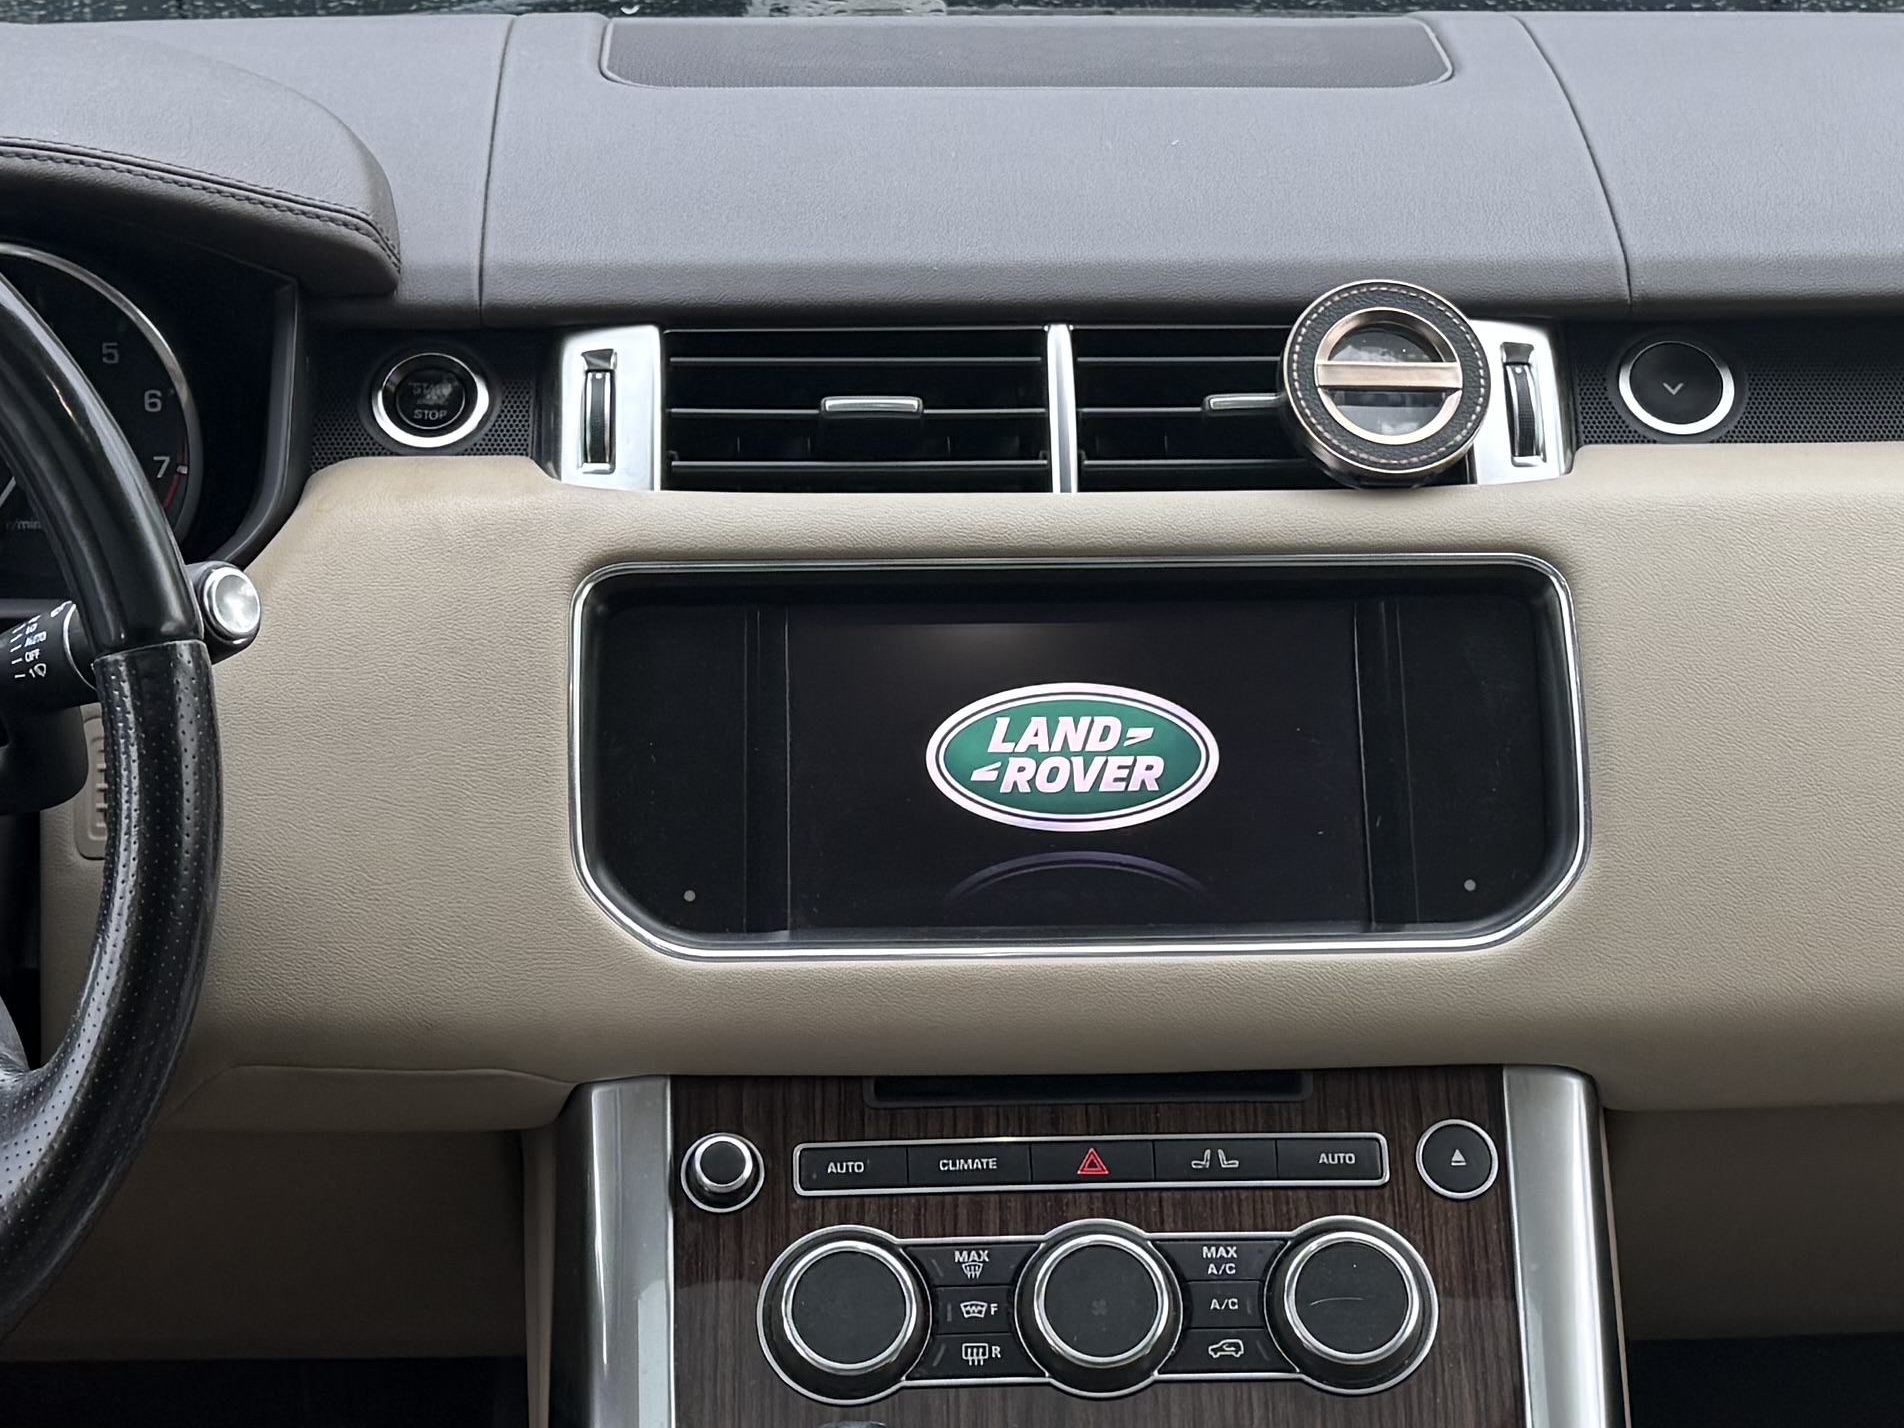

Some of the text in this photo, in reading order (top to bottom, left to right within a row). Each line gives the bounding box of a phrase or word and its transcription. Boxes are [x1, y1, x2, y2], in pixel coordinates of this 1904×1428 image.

[102, 342, 119, 364] 5
[144, 390, 162, 412] 6
[414, 409, 447, 420] STOP
[153, 456, 170, 478] 7
[25, 649, 40, 662] OFF
[987, 716, 1122, 753] LAND
[999, 755, 1165, 793] ROVER
[939, 1158, 998, 1171] CLIMATE
[1319, 1153, 1356, 1164] AUTO
[827, 1161, 865, 1174] AUTO
[954, 1250, 990, 1262] MAX
[1202, 1246, 1237, 1259] MAX
[1207, 1263, 1236, 1275] A/C
[990, 1303, 998, 1316] F
[1210, 1298, 1239, 1310] A/C
[991, 1345, 1001, 1359] R
